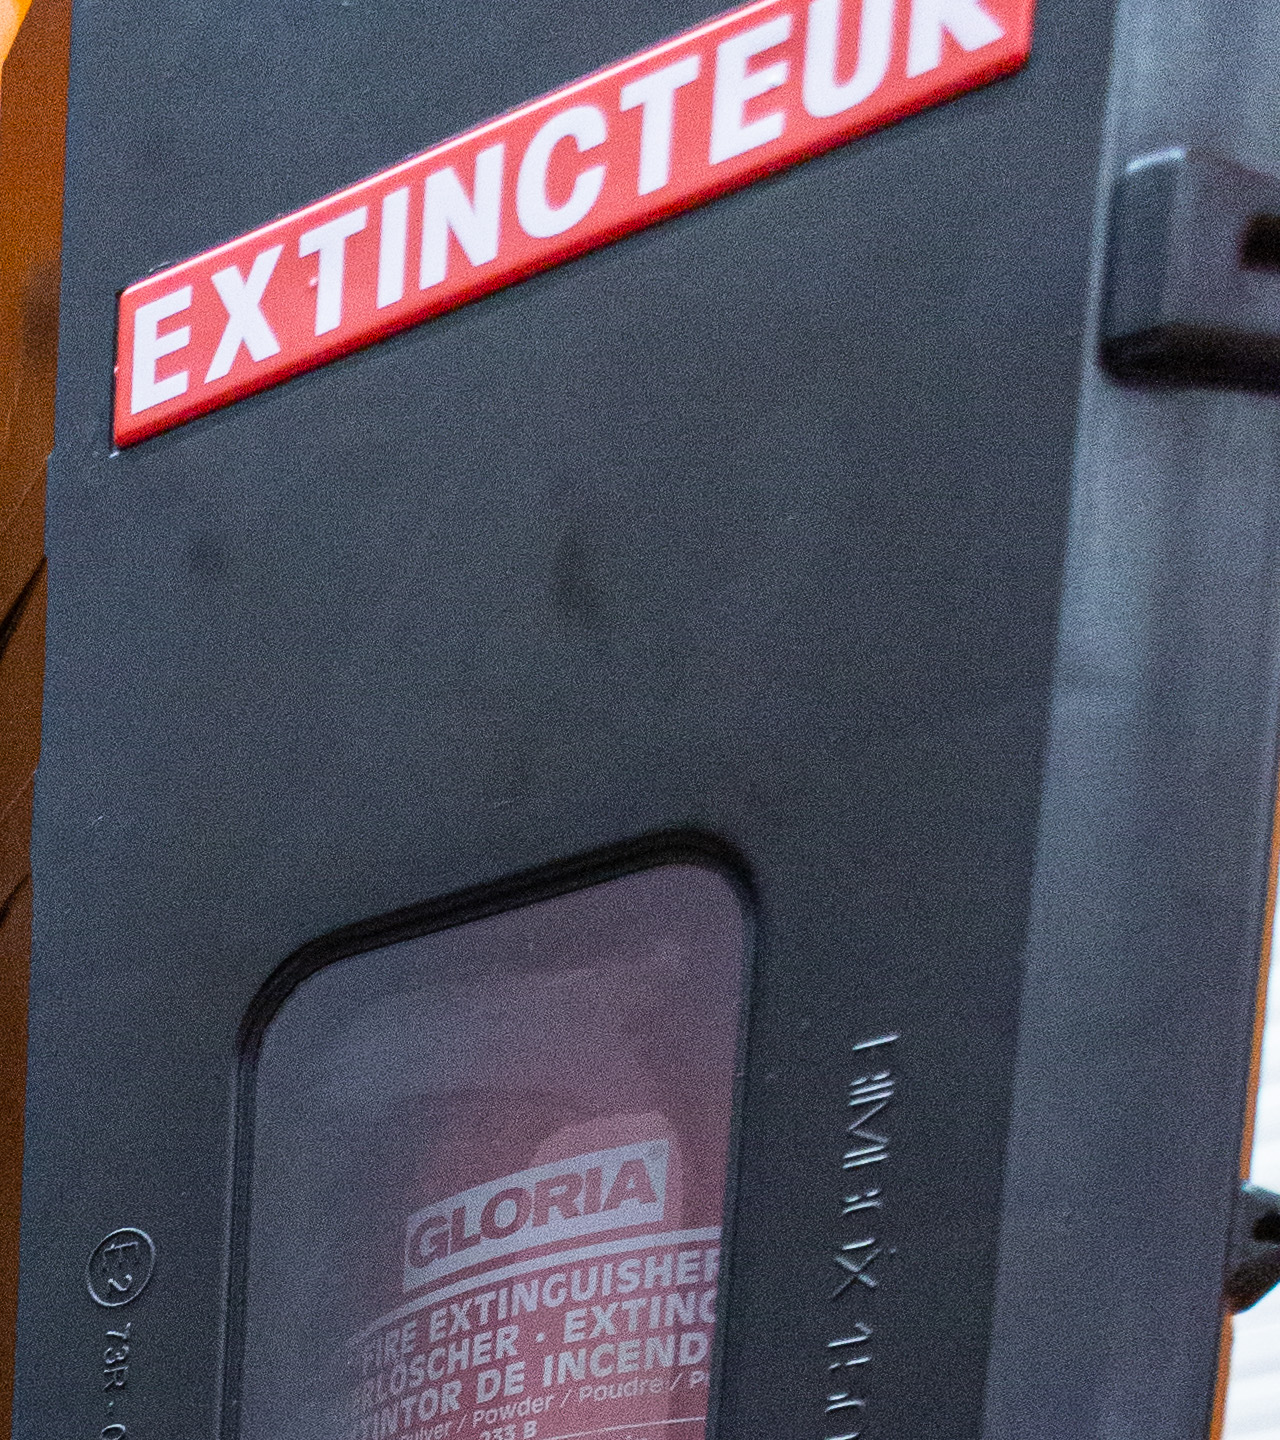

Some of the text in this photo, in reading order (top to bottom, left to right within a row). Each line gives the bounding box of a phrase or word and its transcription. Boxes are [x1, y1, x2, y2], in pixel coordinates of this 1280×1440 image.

[130, 0, 1005, 417] EXTINCTEUR
[412, 1158, 657, 1269] GLORIA
[472, 1393, 554, 1425] Powder
[579, 1374, 663, 1404] Poudre
[475, 1360, 526, 1405] DE
[540, 1331, 710, 1389] INCEND
